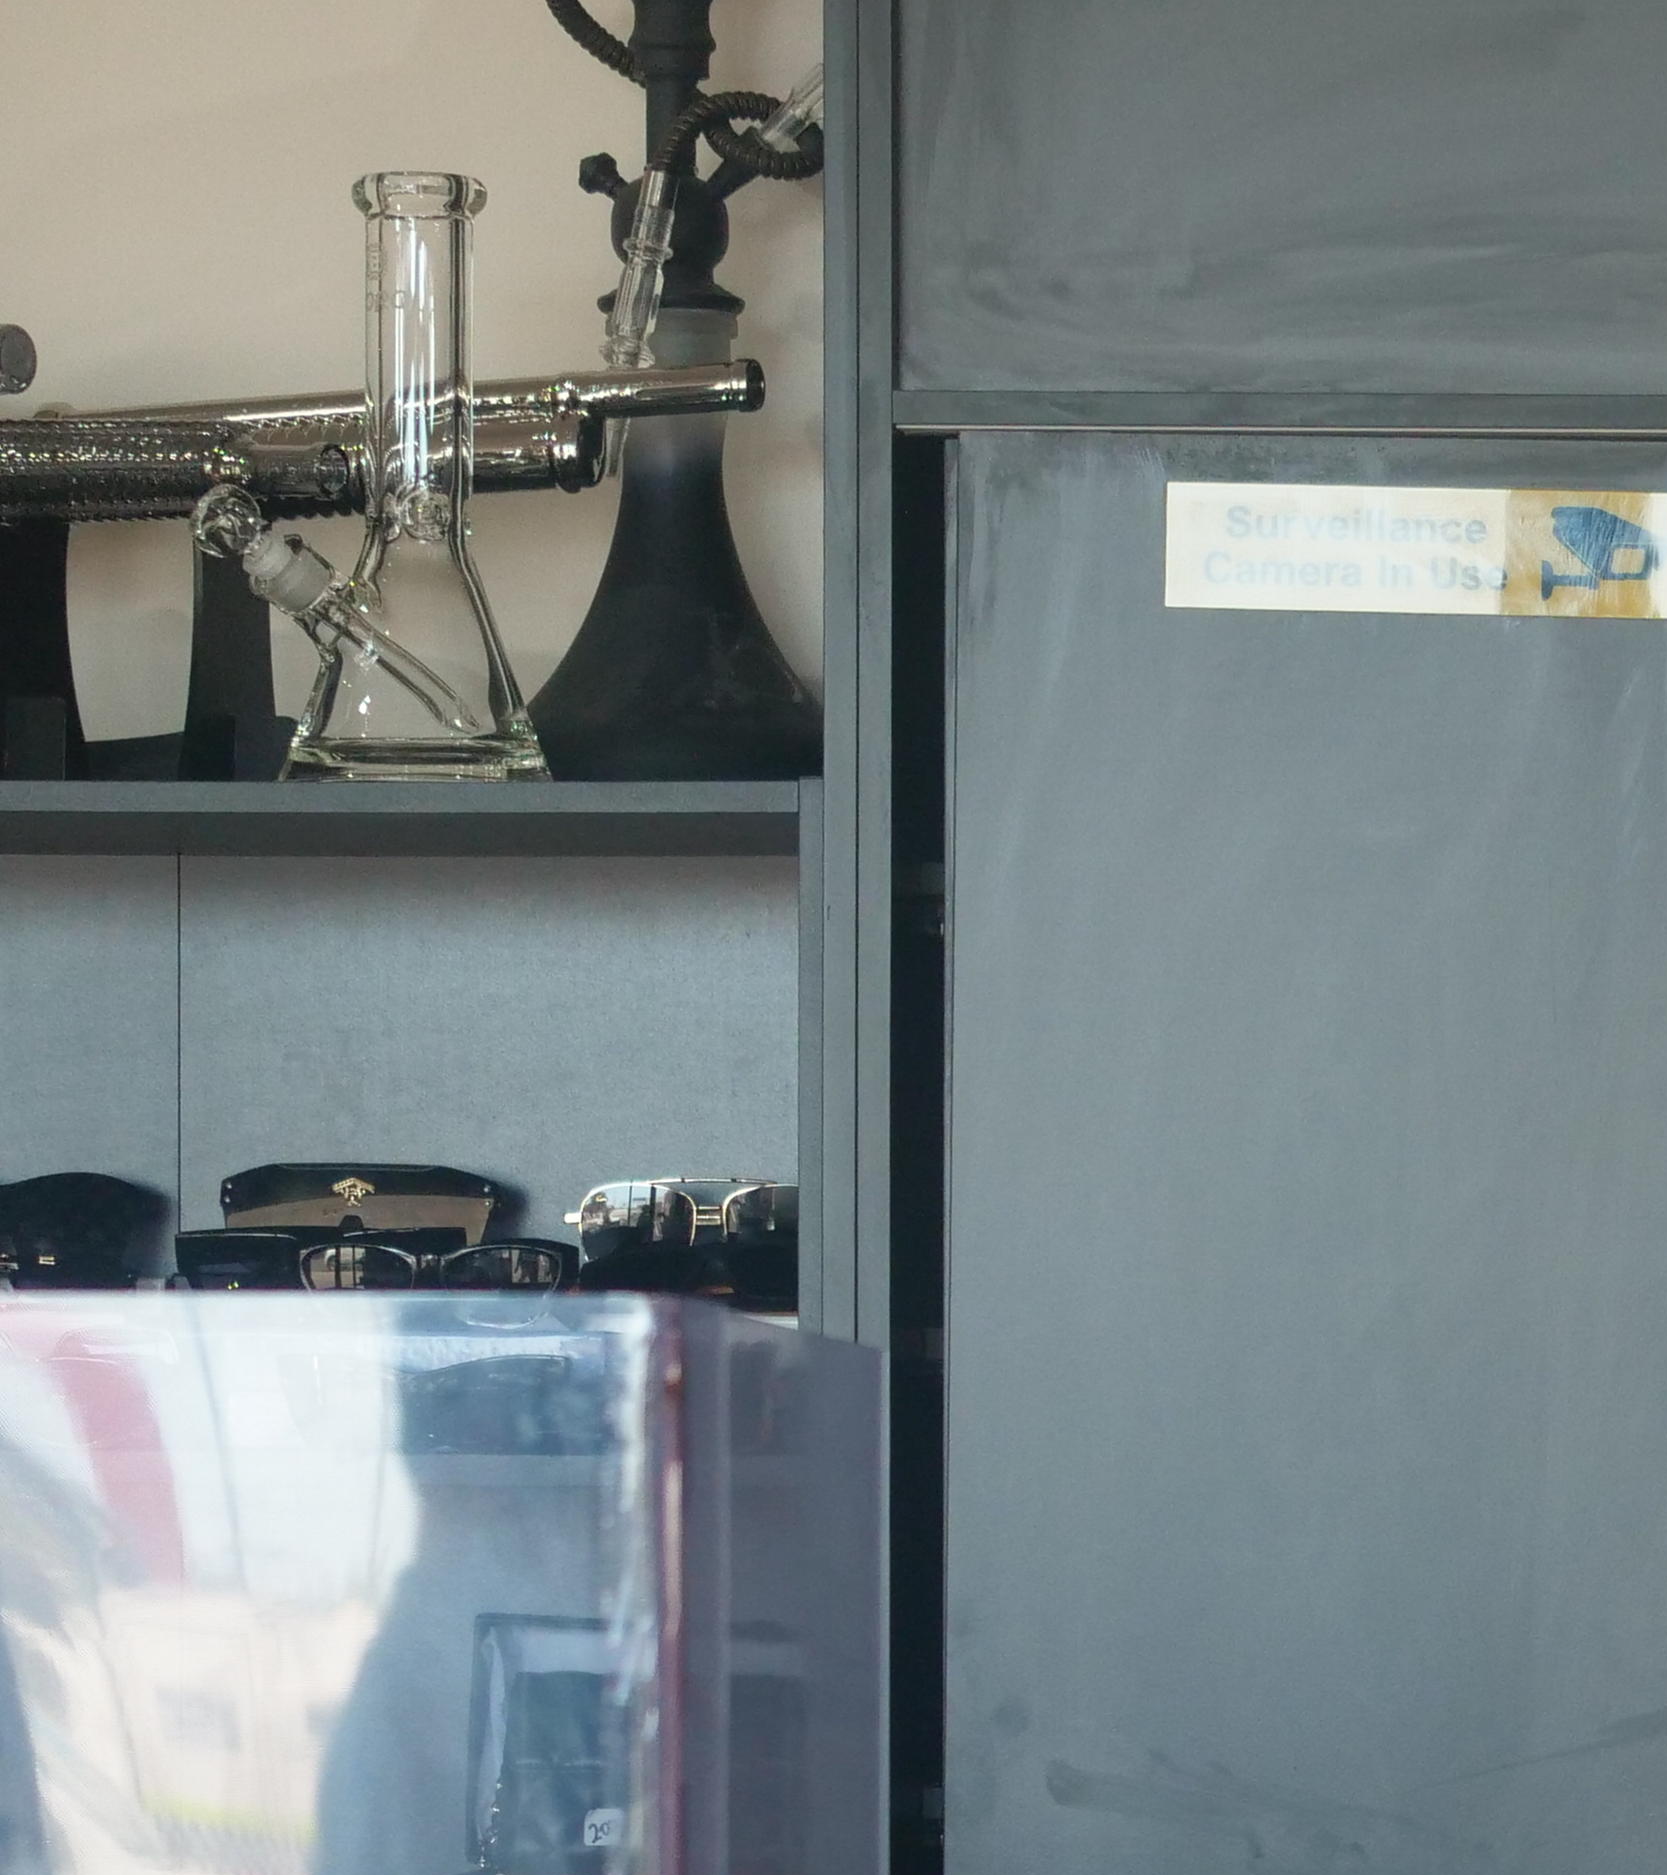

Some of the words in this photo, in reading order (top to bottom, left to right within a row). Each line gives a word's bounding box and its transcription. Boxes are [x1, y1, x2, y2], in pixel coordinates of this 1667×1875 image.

[1226, 505, 1489, 546] Surveillance
[1204, 551, 1363, 589] Camera
[1378, 553, 1411, 589] In
[1431, 555, 1509, 592] Use
